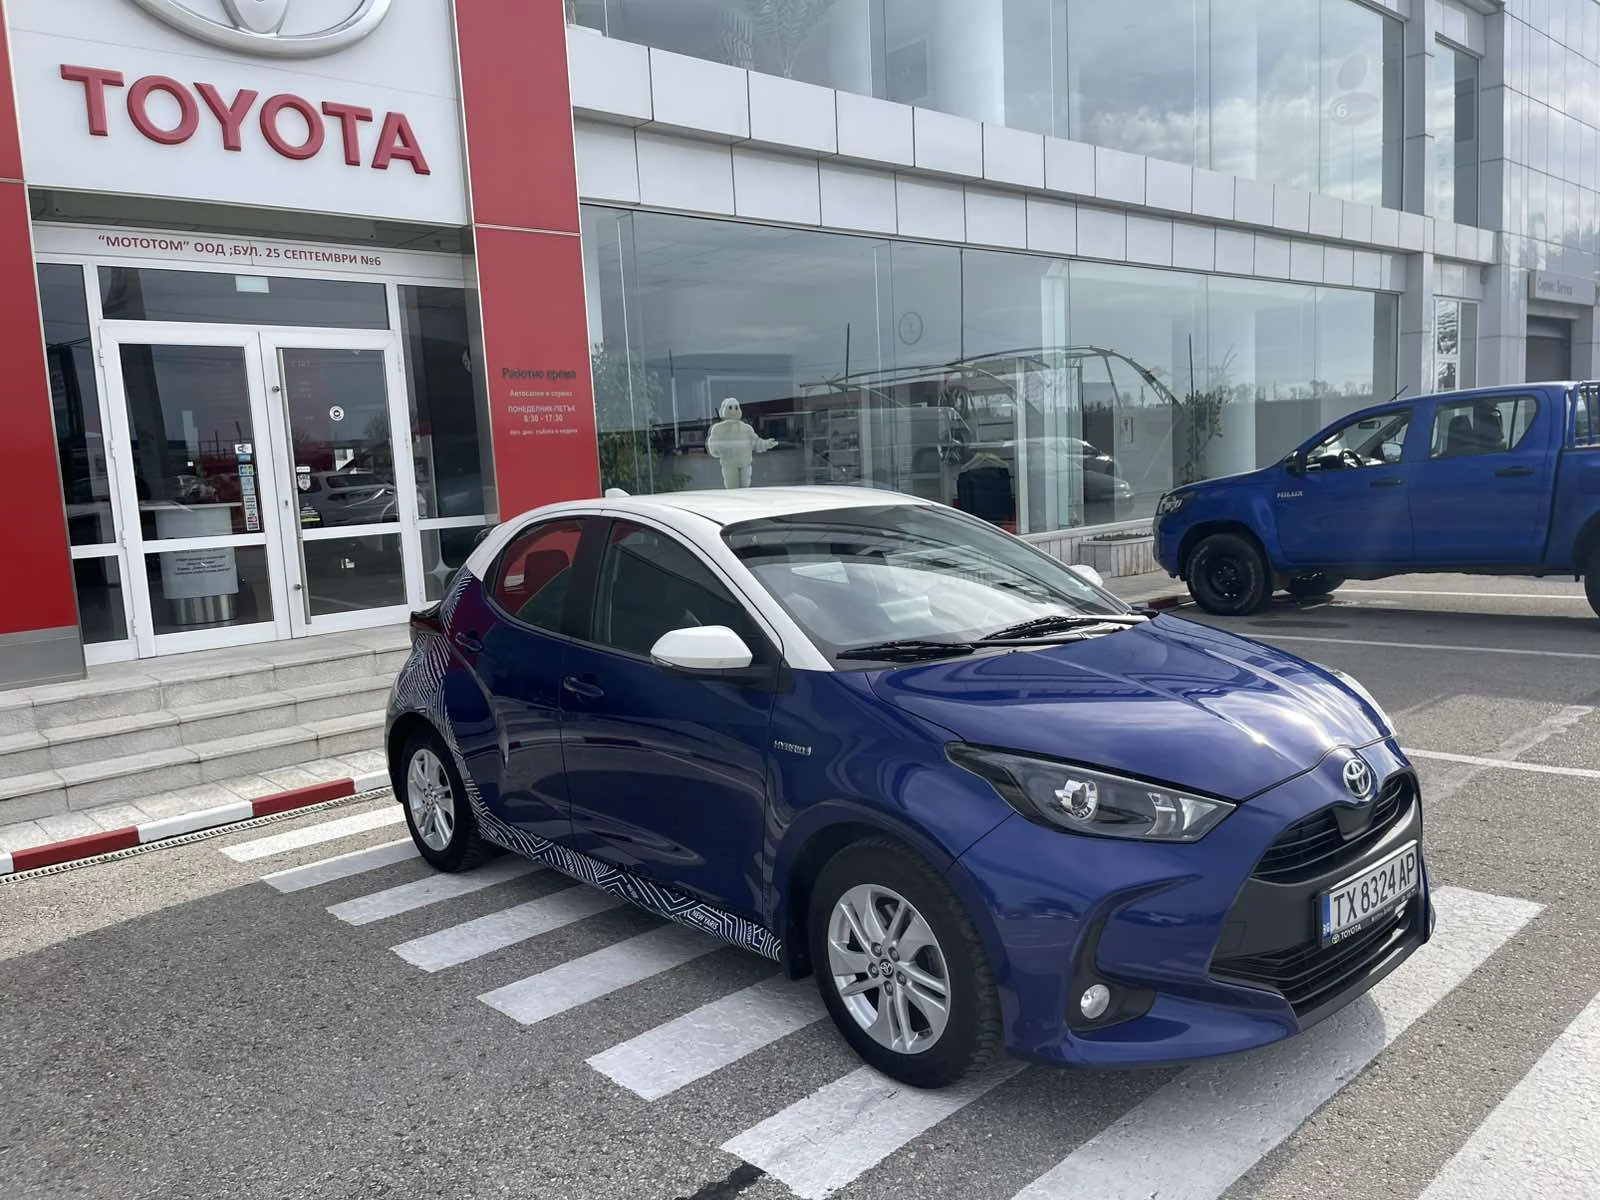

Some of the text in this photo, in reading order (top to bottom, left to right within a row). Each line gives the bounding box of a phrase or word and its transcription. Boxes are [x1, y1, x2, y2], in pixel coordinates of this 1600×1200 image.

[60, 63, 431, 175] TOYOTA
[194, 242, 226, 256] ООД
[266, 247, 280, 258] 25
[284, 249, 357, 264] СЕПТЕМВРИ
[361, 255, 381, 266] №6
[523, 415, 539, 423] 8:30
[1333, 886, 1358, 928] TX
[1361, 864, 1396, 914] 8324
[1399, 852, 1415, 888] AP
[1340, 923, 1362, 938] TOYOTA
